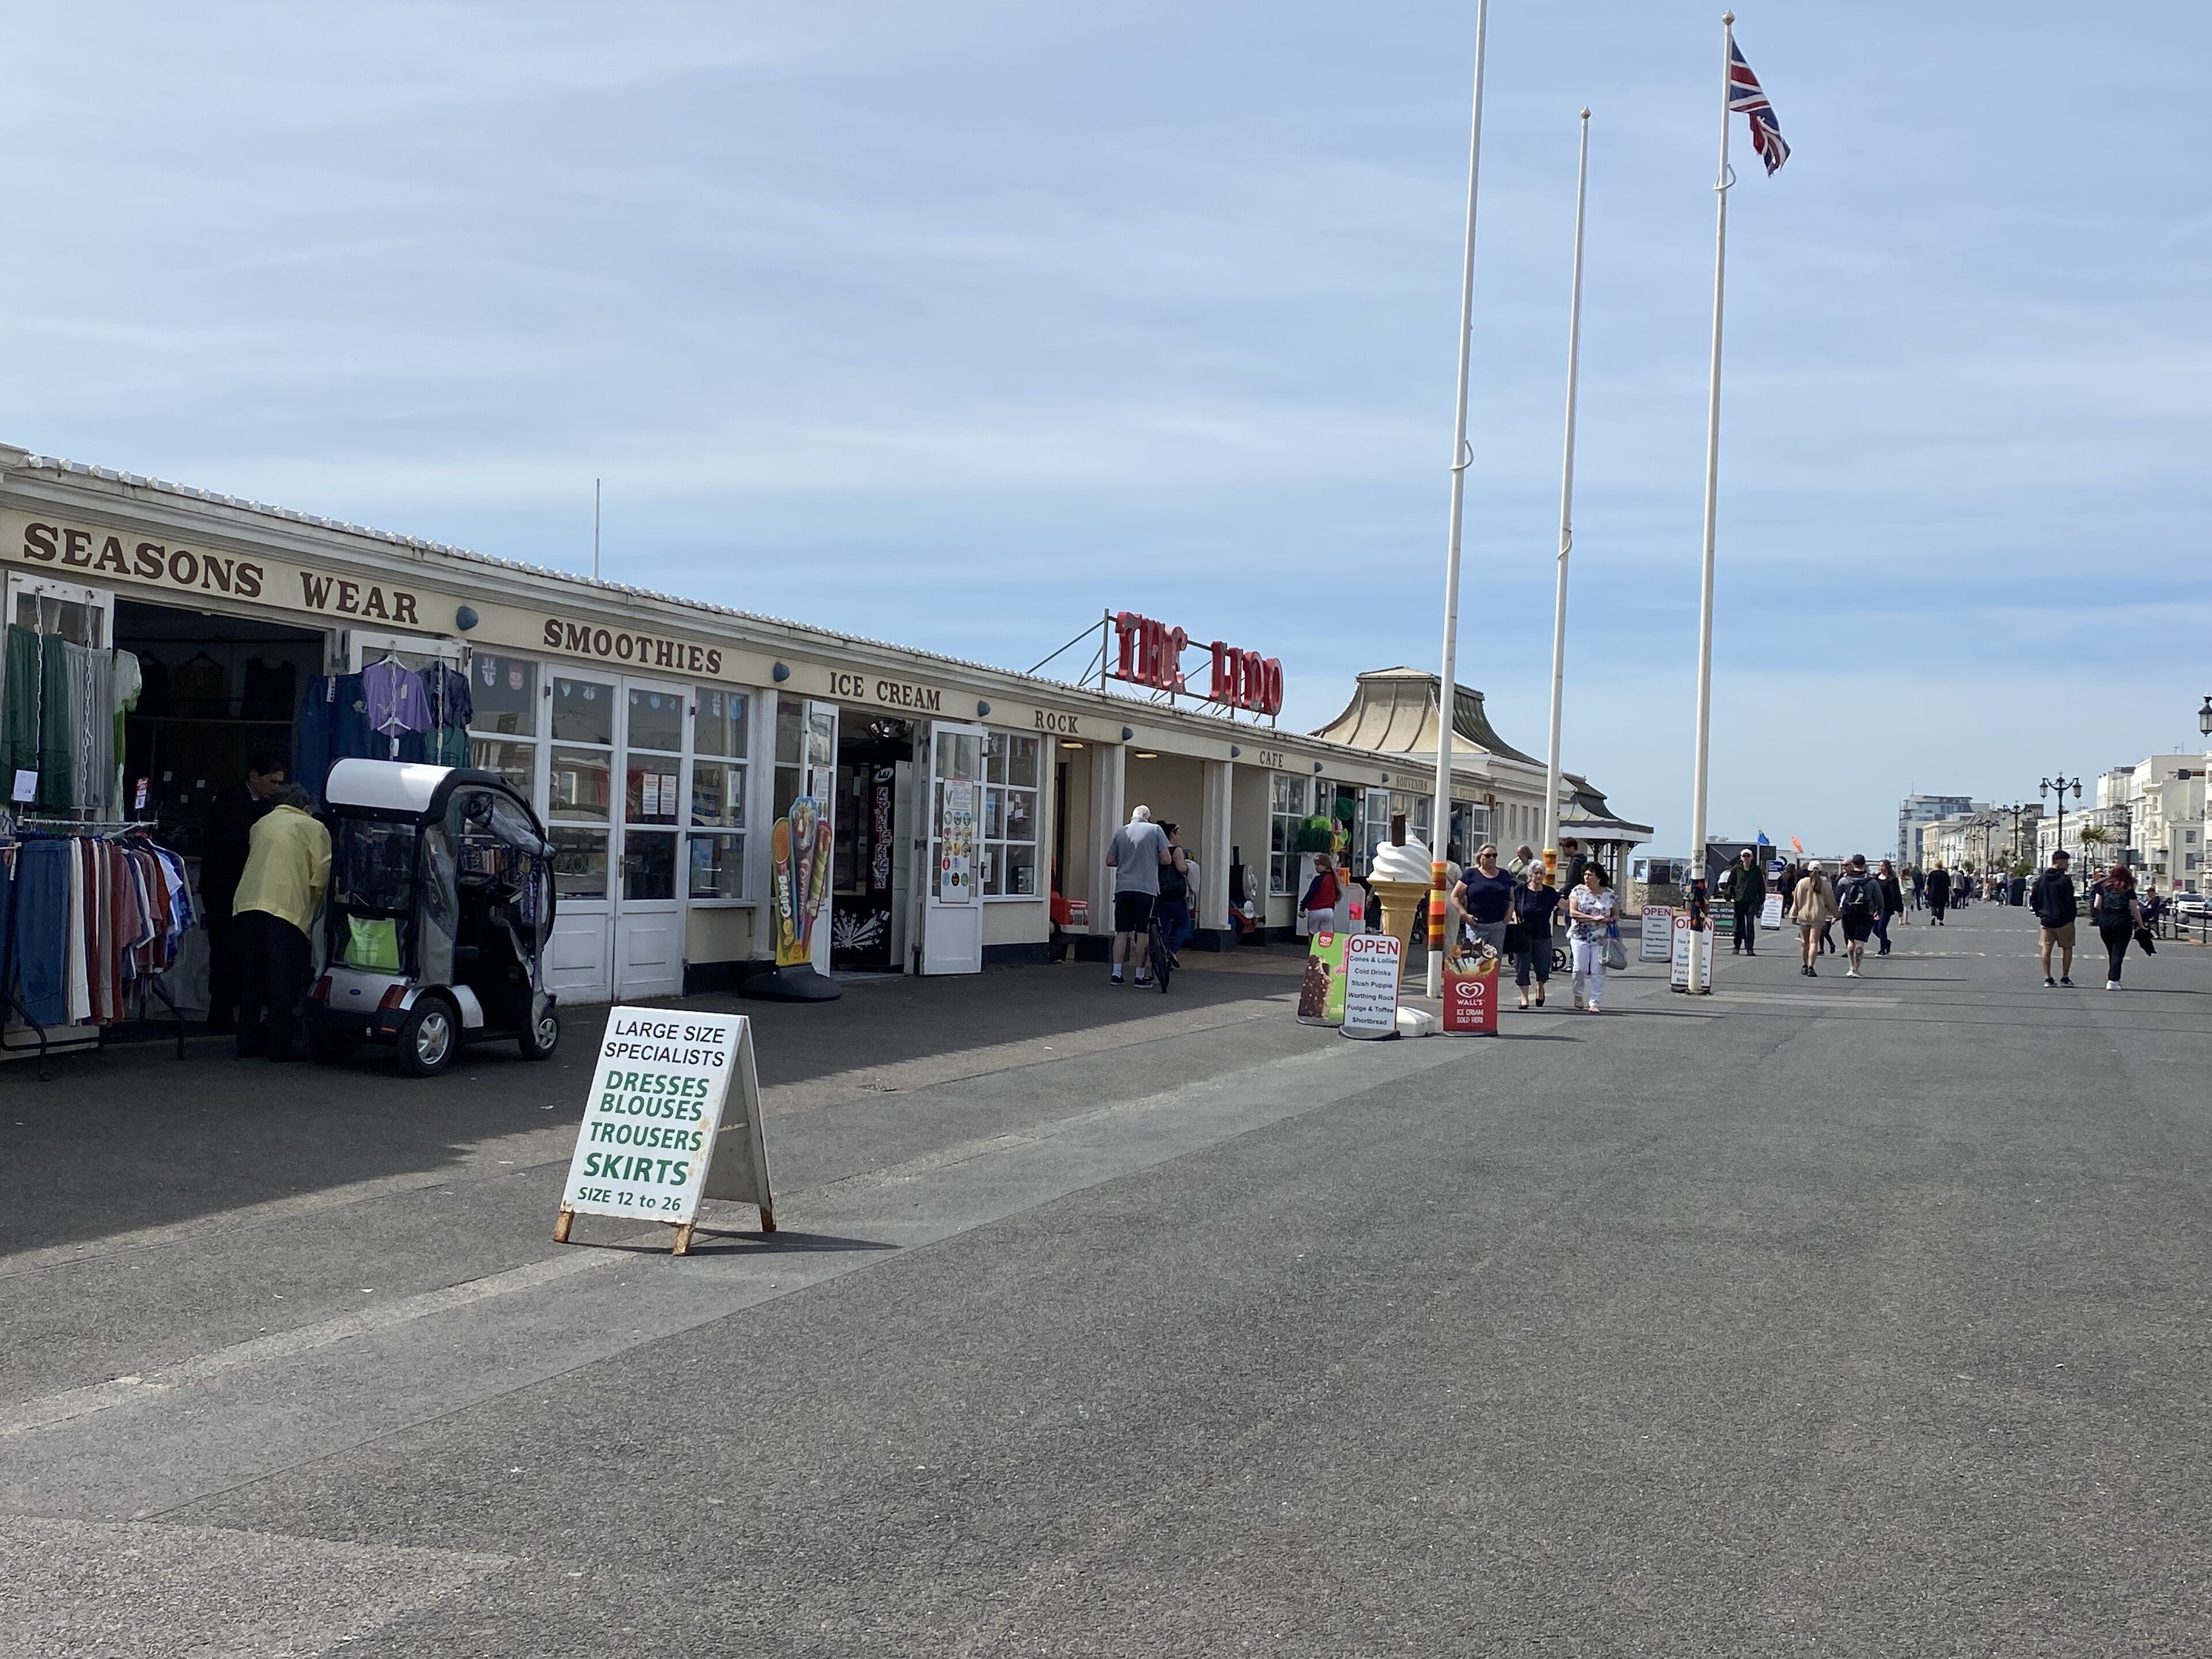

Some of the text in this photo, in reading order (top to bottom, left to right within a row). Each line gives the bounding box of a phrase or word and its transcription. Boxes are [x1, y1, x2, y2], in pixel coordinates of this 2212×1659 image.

[23, 522, 419, 624] SEASONS WEAR
[543, 619, 722, 675] SMOOTHIES
[1115, 612, 1283, 716] THE LIDO
[830, 671, 941, 711] ICE CREAM
[1035, 710, 1079, 734] ROCK
[1259, 750, 1284, 768] CAFE
[1396, 775, 1428, 791] SOUVENIRS
[1643, 907, 1671, 916] OPEN
[1351, 939, 1399, 955] OPEN
[1347, 1004, 1366, 1012] Fudge
[1348, 992, 1377, 1001] Worthing
[615, 1020, 726, 1044] LARGE SIZE
[1352, 1017, 1387, 1025] Shortbread
[604, 1042, 725, 1067] SPECIALISTS
[605, 1070, 710, 1098] DRESSES
[599, 1093, 704, 1122] BLOUSES
[589, 1122, 703, 1152] TROUSERS
[583, 1152, 690, 1186] SKIRTS
[577, 1187, 682, 1211] SIZE 12 to 26
